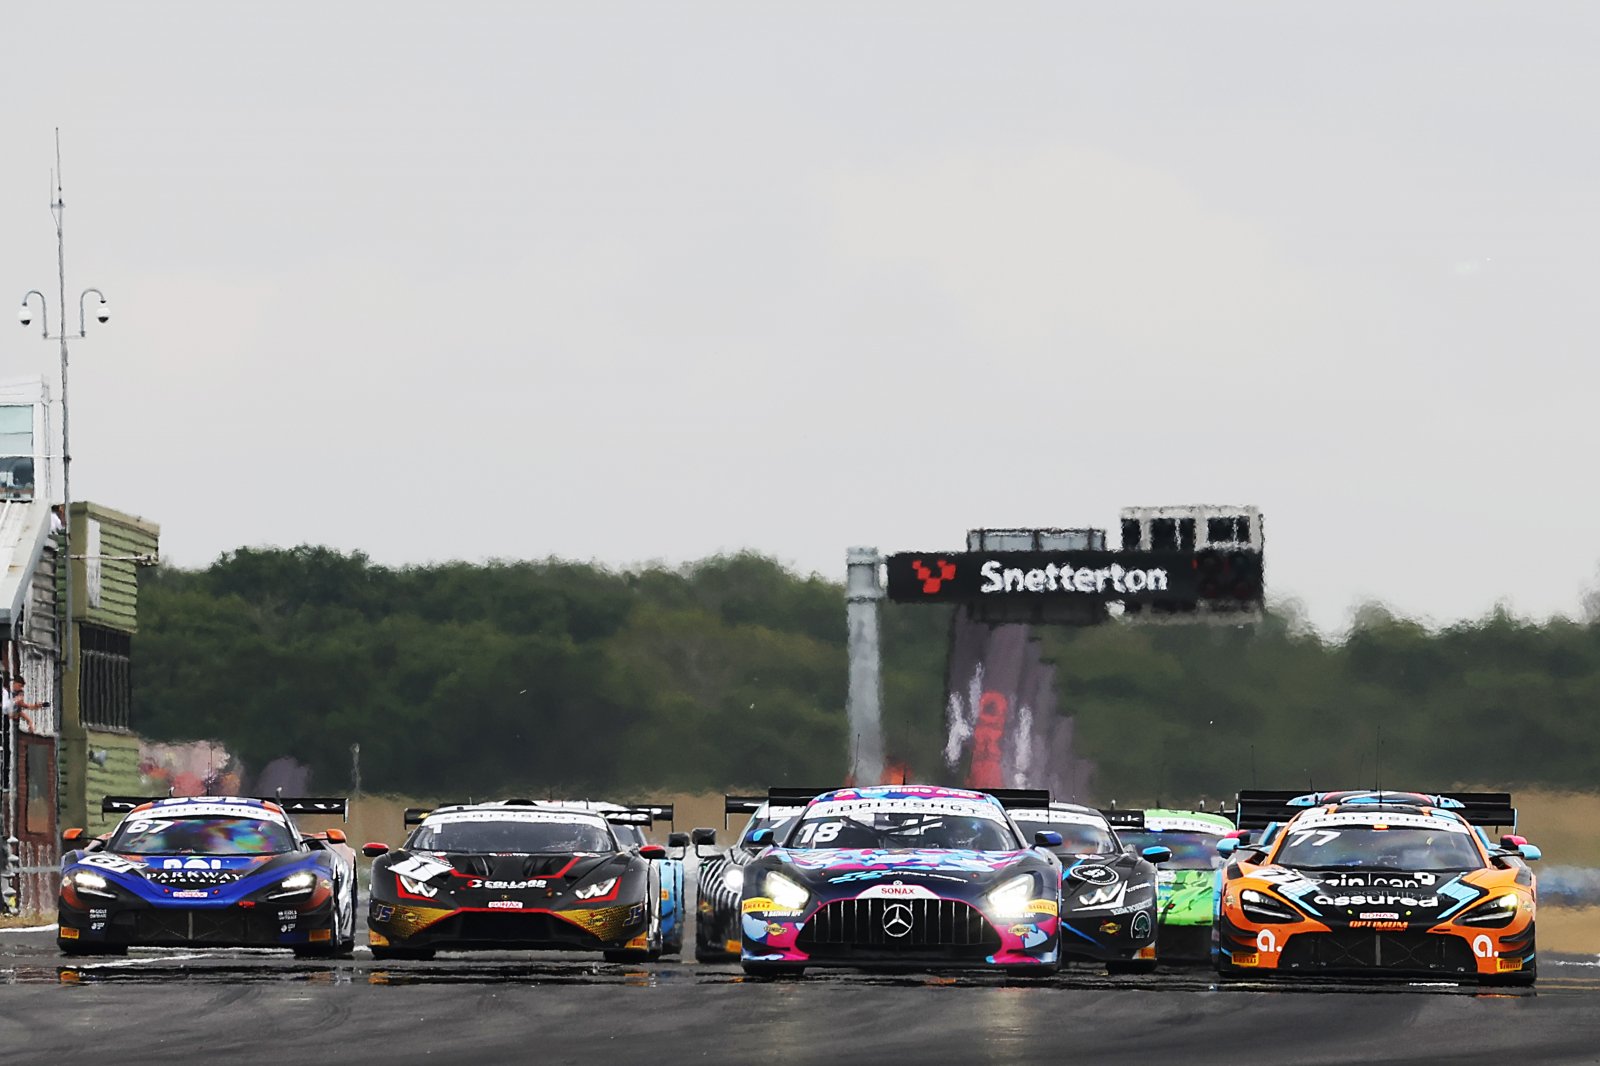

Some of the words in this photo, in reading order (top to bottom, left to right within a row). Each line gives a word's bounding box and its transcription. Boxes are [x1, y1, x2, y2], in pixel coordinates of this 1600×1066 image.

[980, 560, 1168, 593] Snetterton
[126, 819, 175, 834] 67
[801, 821, 843, 844] 18
[1289, 830, 1342, 848] 77
[146, 870, 244, 881] PARKWAY
[880, 887, 916, 896] SONAX
[1313, 894, 1440, 908] assured
[1349, 920, 1409, 930] OPTIMUM
[1256, 929, 1283, 953] a.
[1473, 934, 1499, 958] a.
